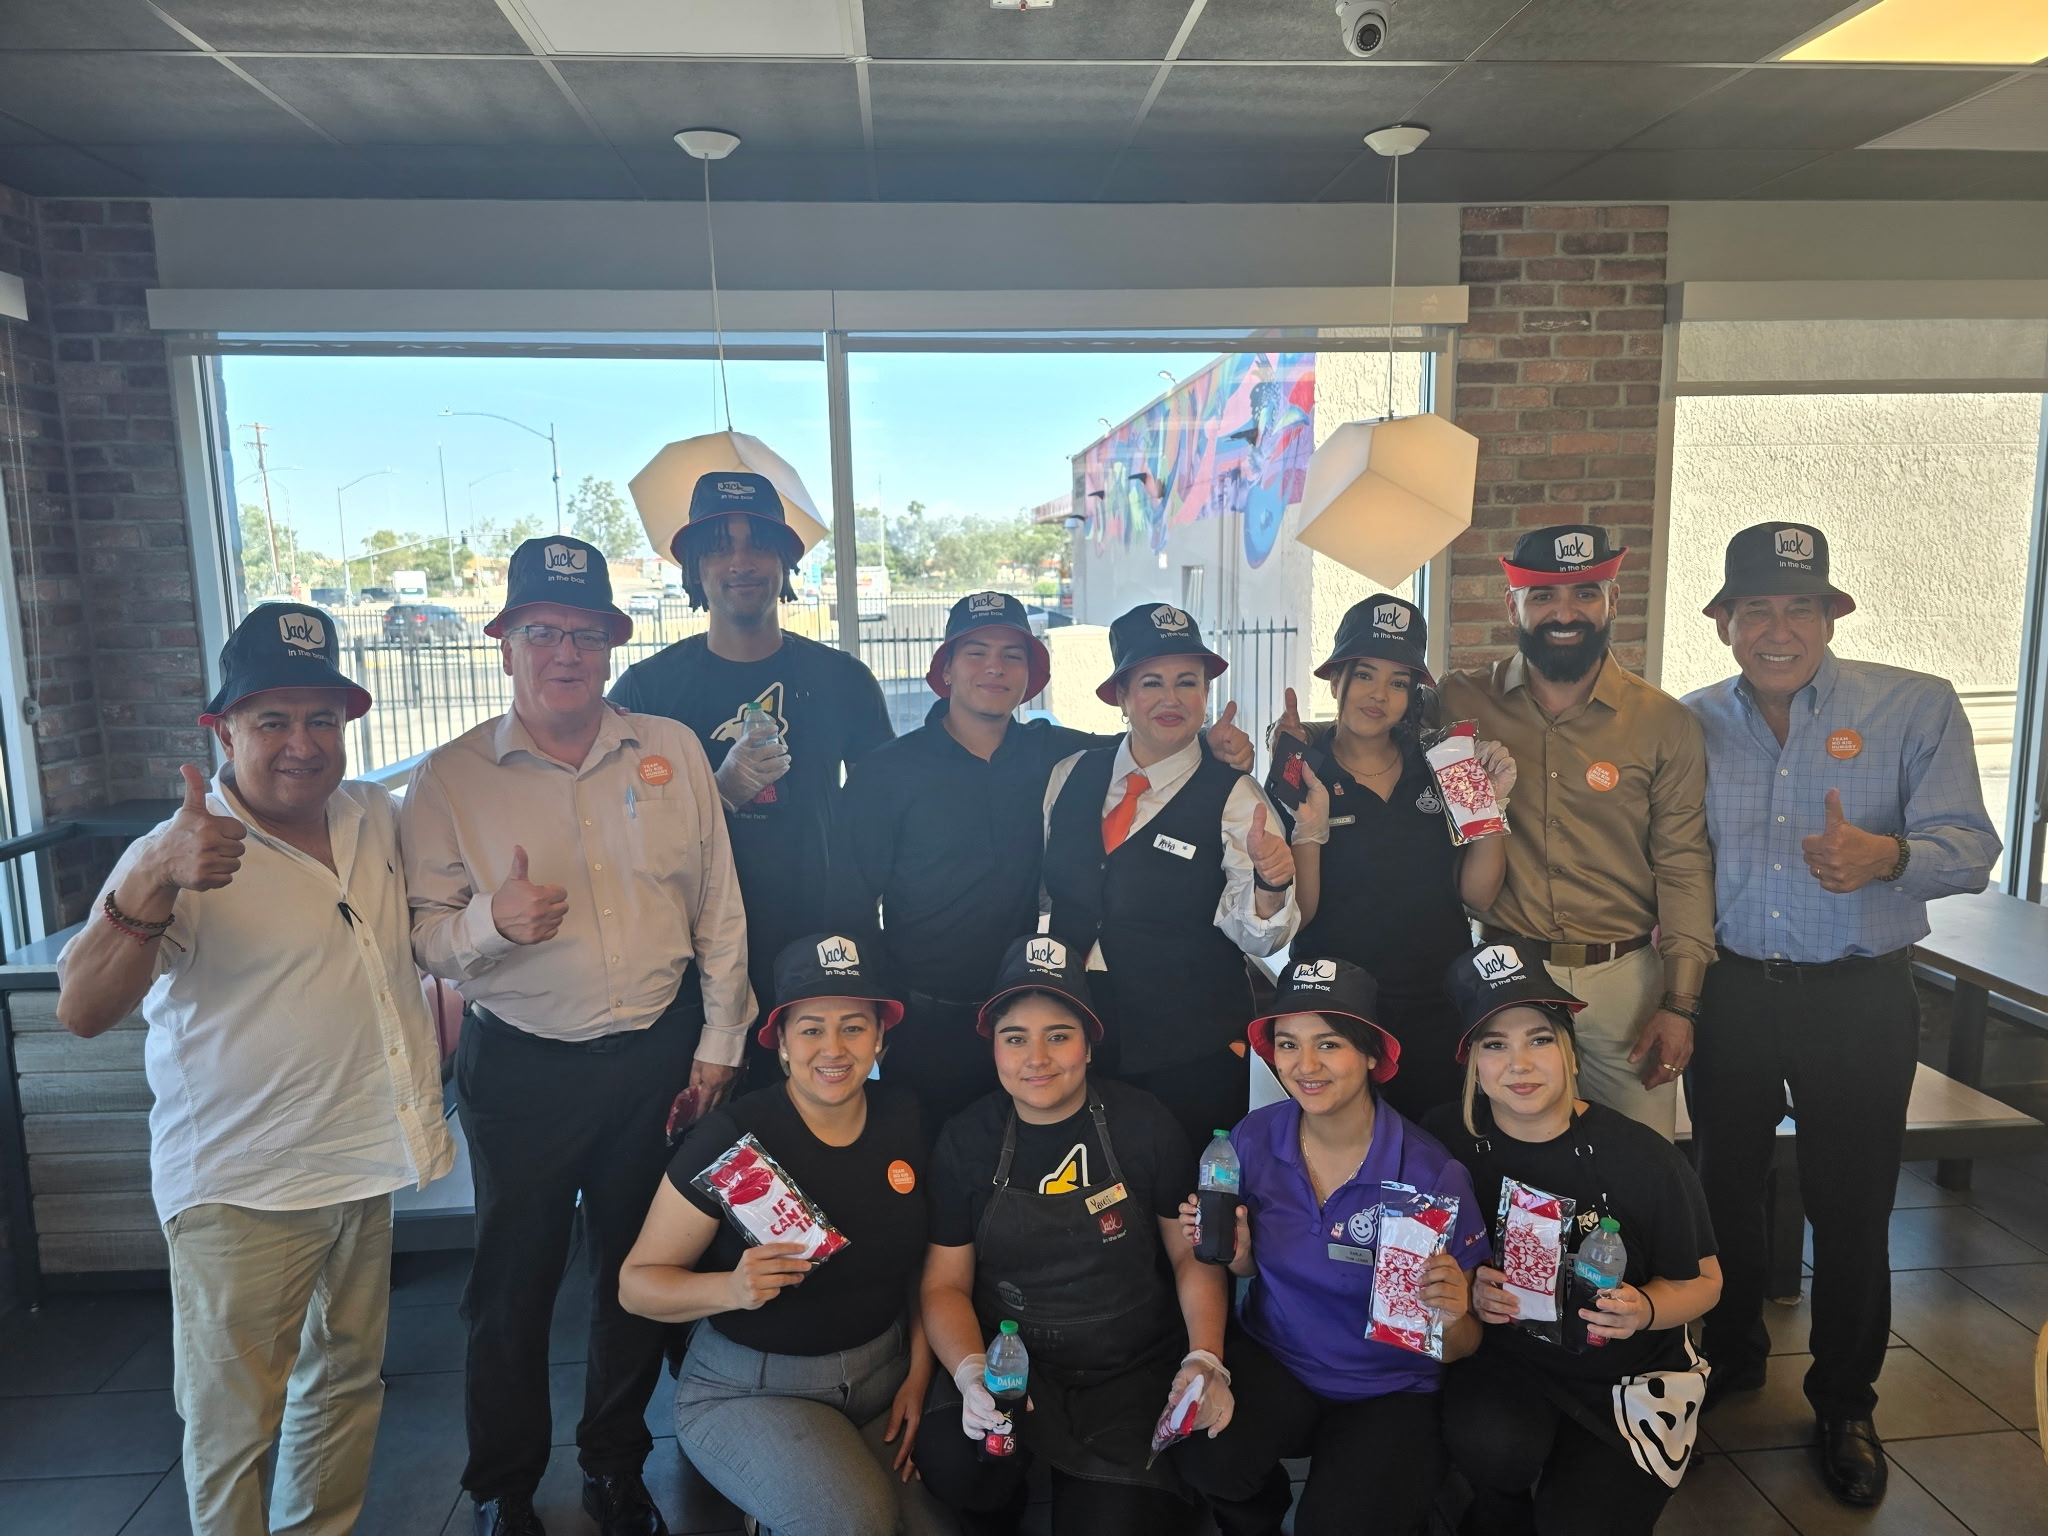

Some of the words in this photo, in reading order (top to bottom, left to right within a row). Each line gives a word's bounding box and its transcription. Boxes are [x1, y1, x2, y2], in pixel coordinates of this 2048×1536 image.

[1557, 536, 1592, 559] Jack
[1777, 532, 1812, 557] Jack
[547, 548, 585, 570] Jack
[571, 576, 585, 584] box
[971, 594, 1003, 610] Jack
[1154, 608, 1186, 626] Jack
[1374, 607, 1408, 629] Jack
[283, 617, 324, 644] Jack
[821, 940, 857, 965] Jack
[1028, 942, 1064, 965] Jack
[1295, 962, 1333, 979] Jack
[1477, 949, 1519, 978] Jack
[1315, 984, 1331, 992] box
[770, 1208, 800, 1236] CAN
[1101, 1214, 1123, 1234] Jack
[1578, 1261, 1601, 1282] DASANI
[997, 1376, 1023, 1388] DASANI
[1003, 1436, 1015, 1449] 75
